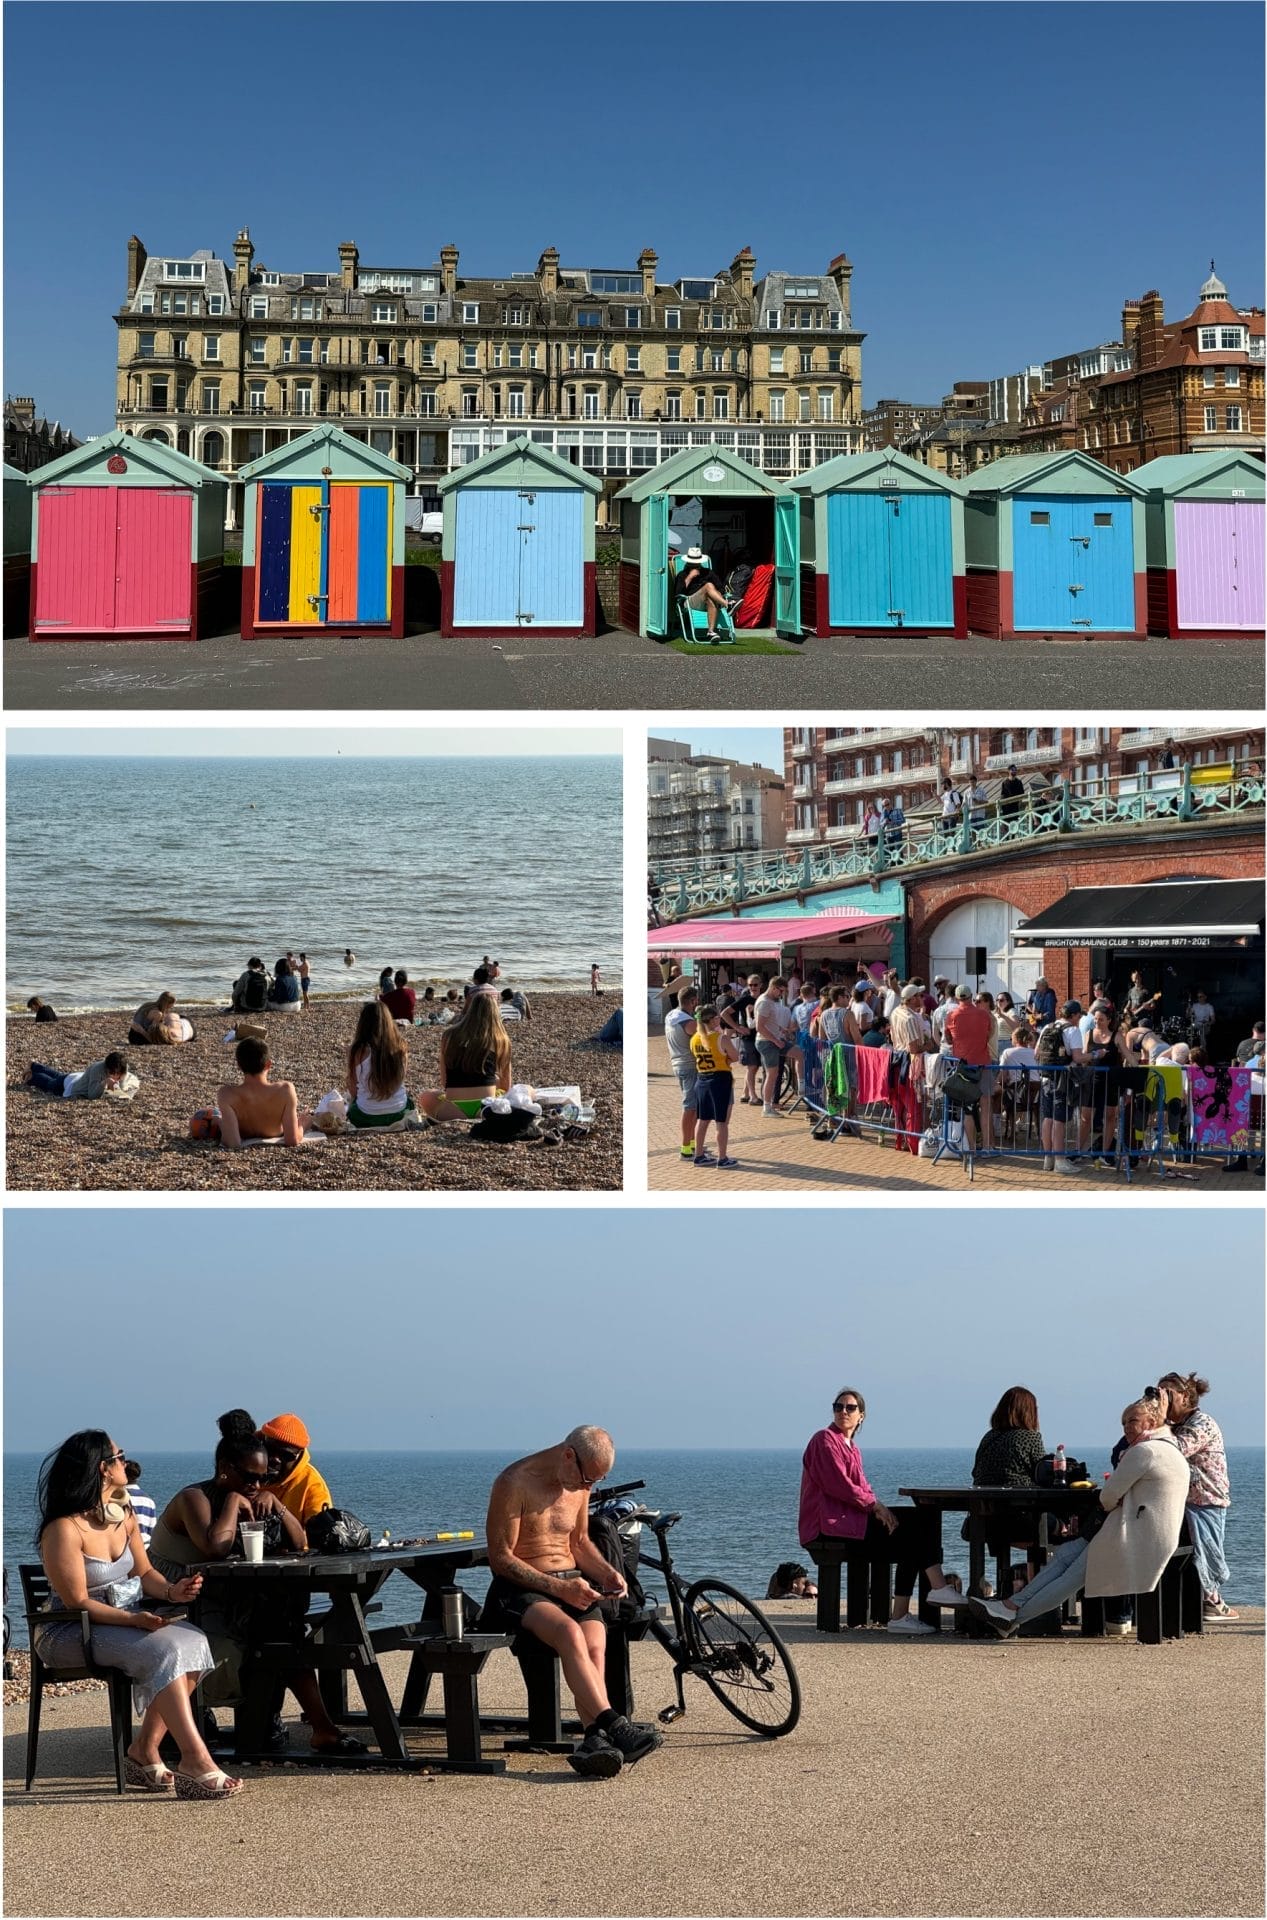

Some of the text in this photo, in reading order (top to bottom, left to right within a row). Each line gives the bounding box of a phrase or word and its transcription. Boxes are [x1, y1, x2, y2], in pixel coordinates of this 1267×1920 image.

[1080, 938, 1107, 946] SAILING
[1109, 938, 1128, 946] CLUB
[1150, 939, 1170, 947] years
[696, 1054, 715, 1070] 25
